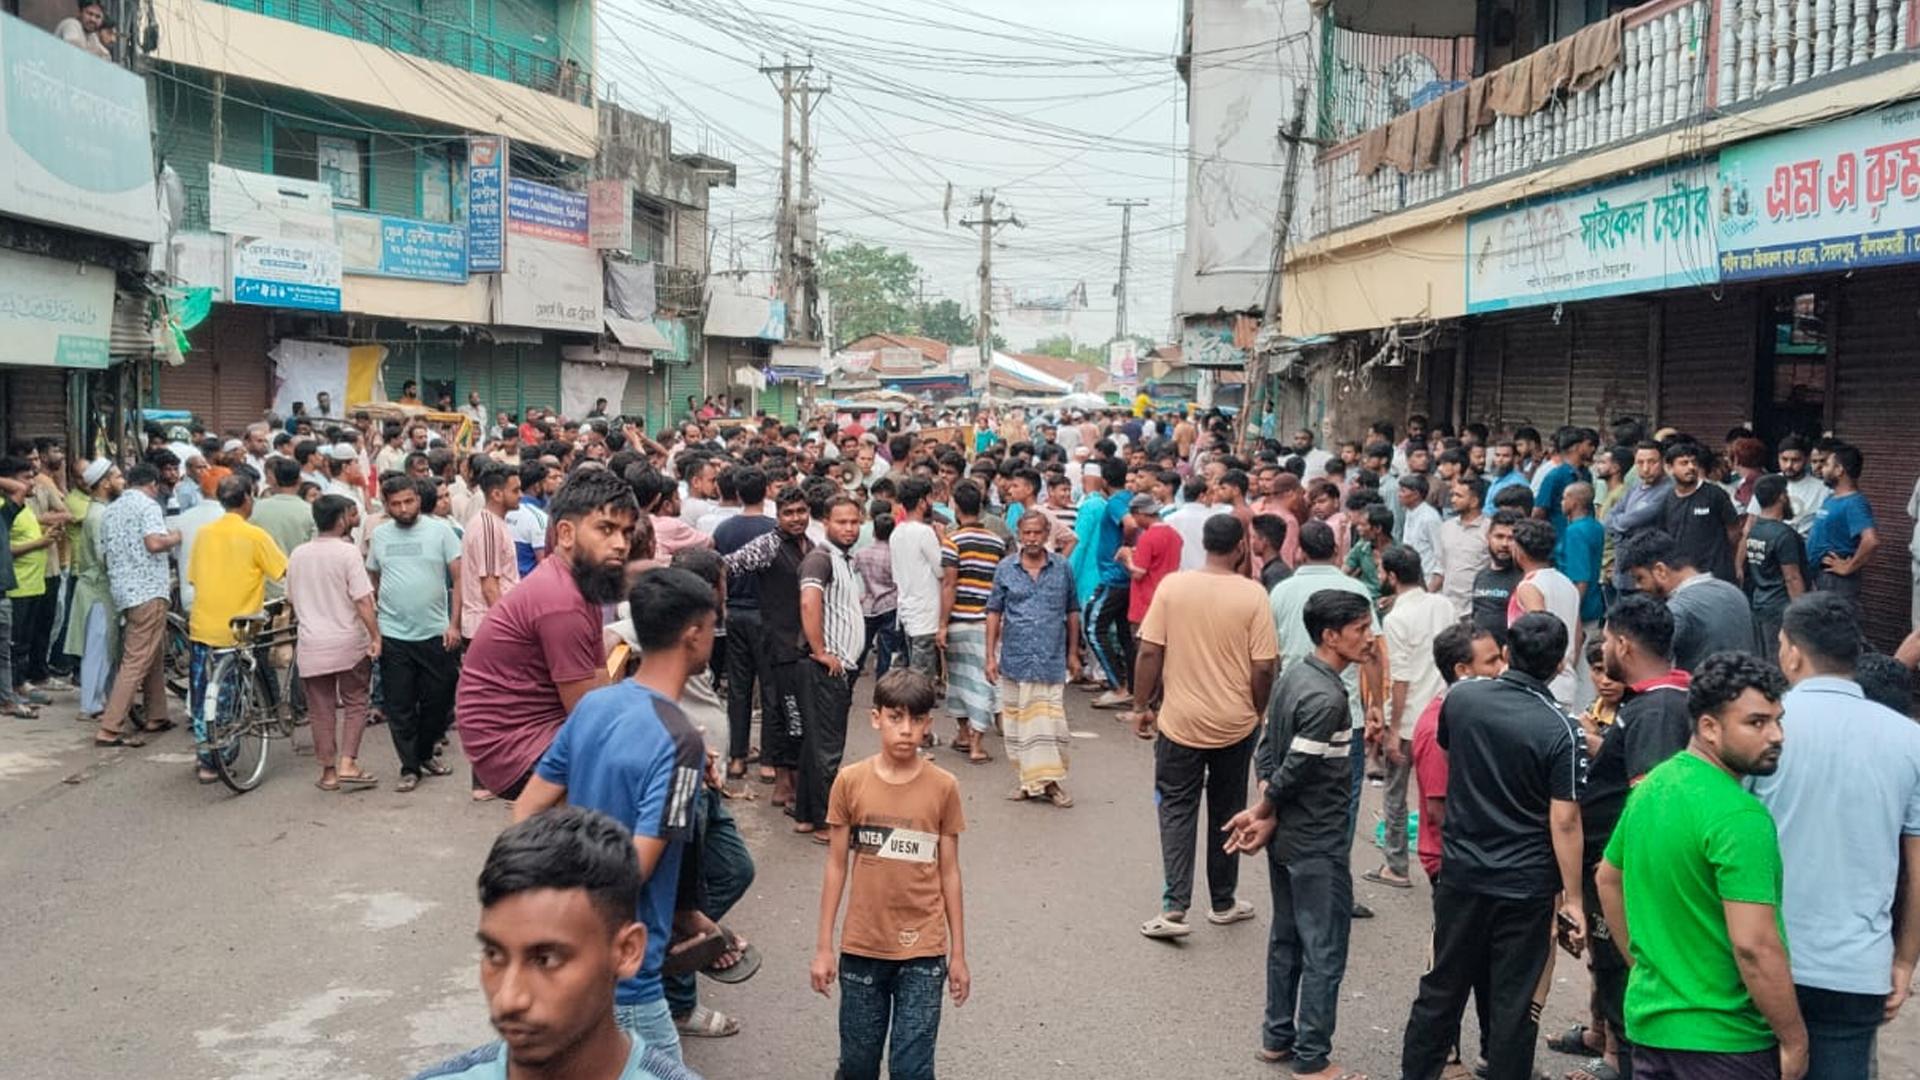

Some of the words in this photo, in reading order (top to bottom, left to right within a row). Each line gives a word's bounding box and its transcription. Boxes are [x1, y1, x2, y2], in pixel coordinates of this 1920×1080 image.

[1766, 158, 1822, 220] এম
[1827, 152, 1858, 211] এ
[1579, 197, 1648, 252] সাইকেল
